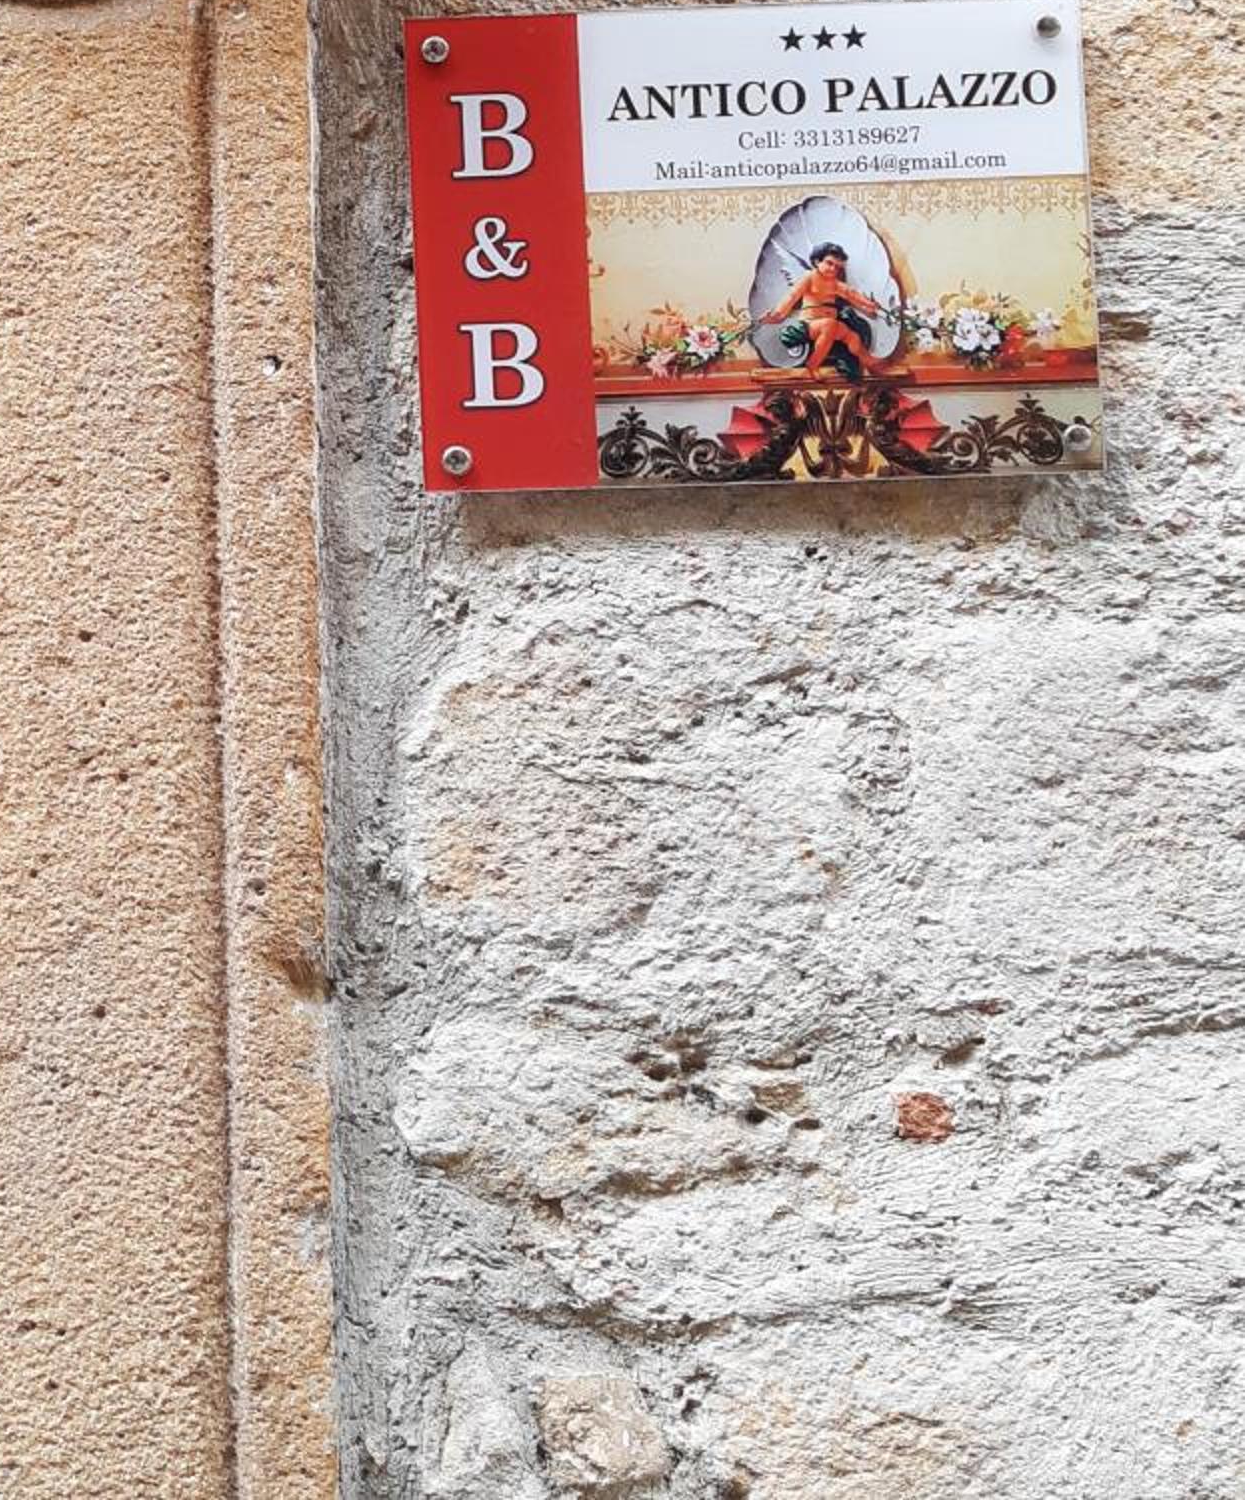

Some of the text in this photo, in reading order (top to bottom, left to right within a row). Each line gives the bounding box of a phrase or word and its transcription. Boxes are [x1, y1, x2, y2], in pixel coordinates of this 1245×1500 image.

[607, 69, 1057, 122] ANTICO PALAZZO
[738, 126, 921, 151] Cell: 3313189627
[655, 152, 1007, 183] Mail:anticopalazzo64@gmail.com
[450, 92, 546, 409] B & B
